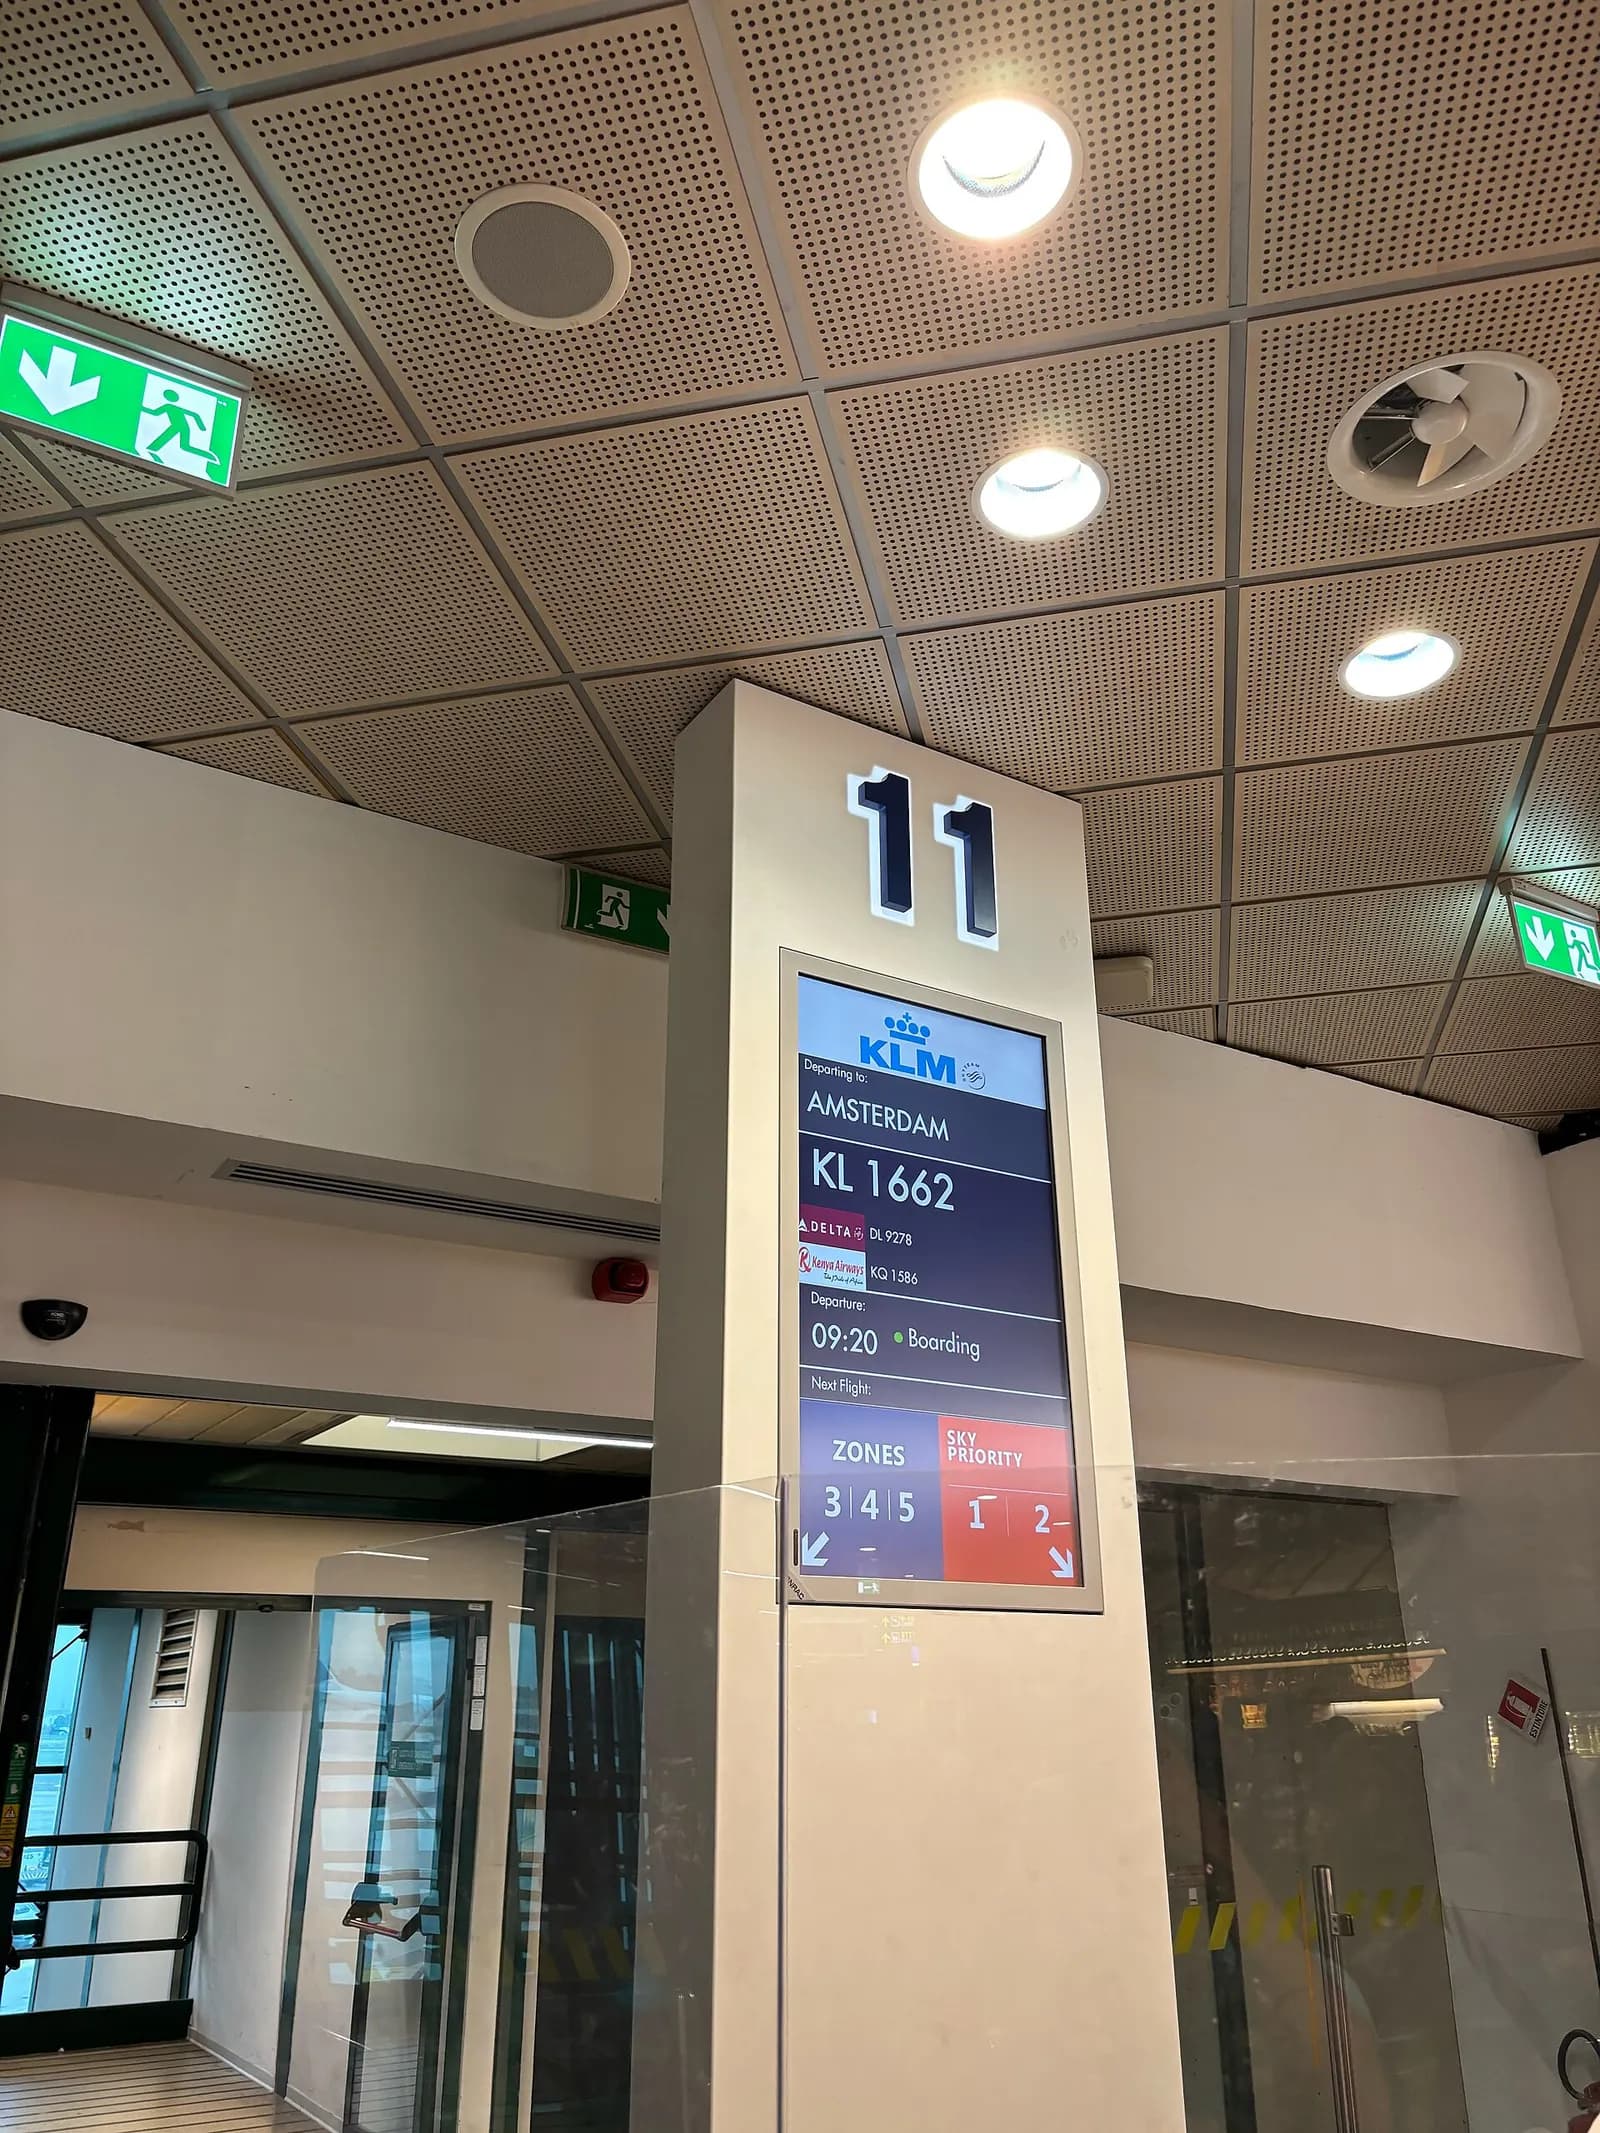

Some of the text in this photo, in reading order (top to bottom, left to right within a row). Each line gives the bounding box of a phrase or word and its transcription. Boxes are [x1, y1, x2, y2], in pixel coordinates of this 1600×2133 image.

[851, 768, 998, 944] 11
[804, 1058, 868, 1084] Departing to:
[859, 1034, 957, 1085] KLM
[806, 1089, 950, 1142] AMSTERDAM
[812, 1147, 955, 1212] KL 1662
[811, 1220, 851, 1238] DELTA
[869, 1227, 913, 1246] DL 9278
[812, 1255, 864, 1277] Kenya Airways
[870, 1265, 919, 1285] KQ 1586
[811, 1291, 866, 1312] Departure:
[811, 1322, 878, 1355] 09:20
[908, 1327, 981, 1362] Boarding
[811, 1376, 872, 1398] Next Flight:
[946, 1429, 977, 1447] SKY
[832, 1439, 906, 1467] ZONES
[947, 1446, 1024, 1468] PRIORITY
[824, 1485, 915, 1523] 3 4 5
[968, 1500, 1050, 1534] 1 2
[1529, 1700, 1548, 1738] ESTINTORE
